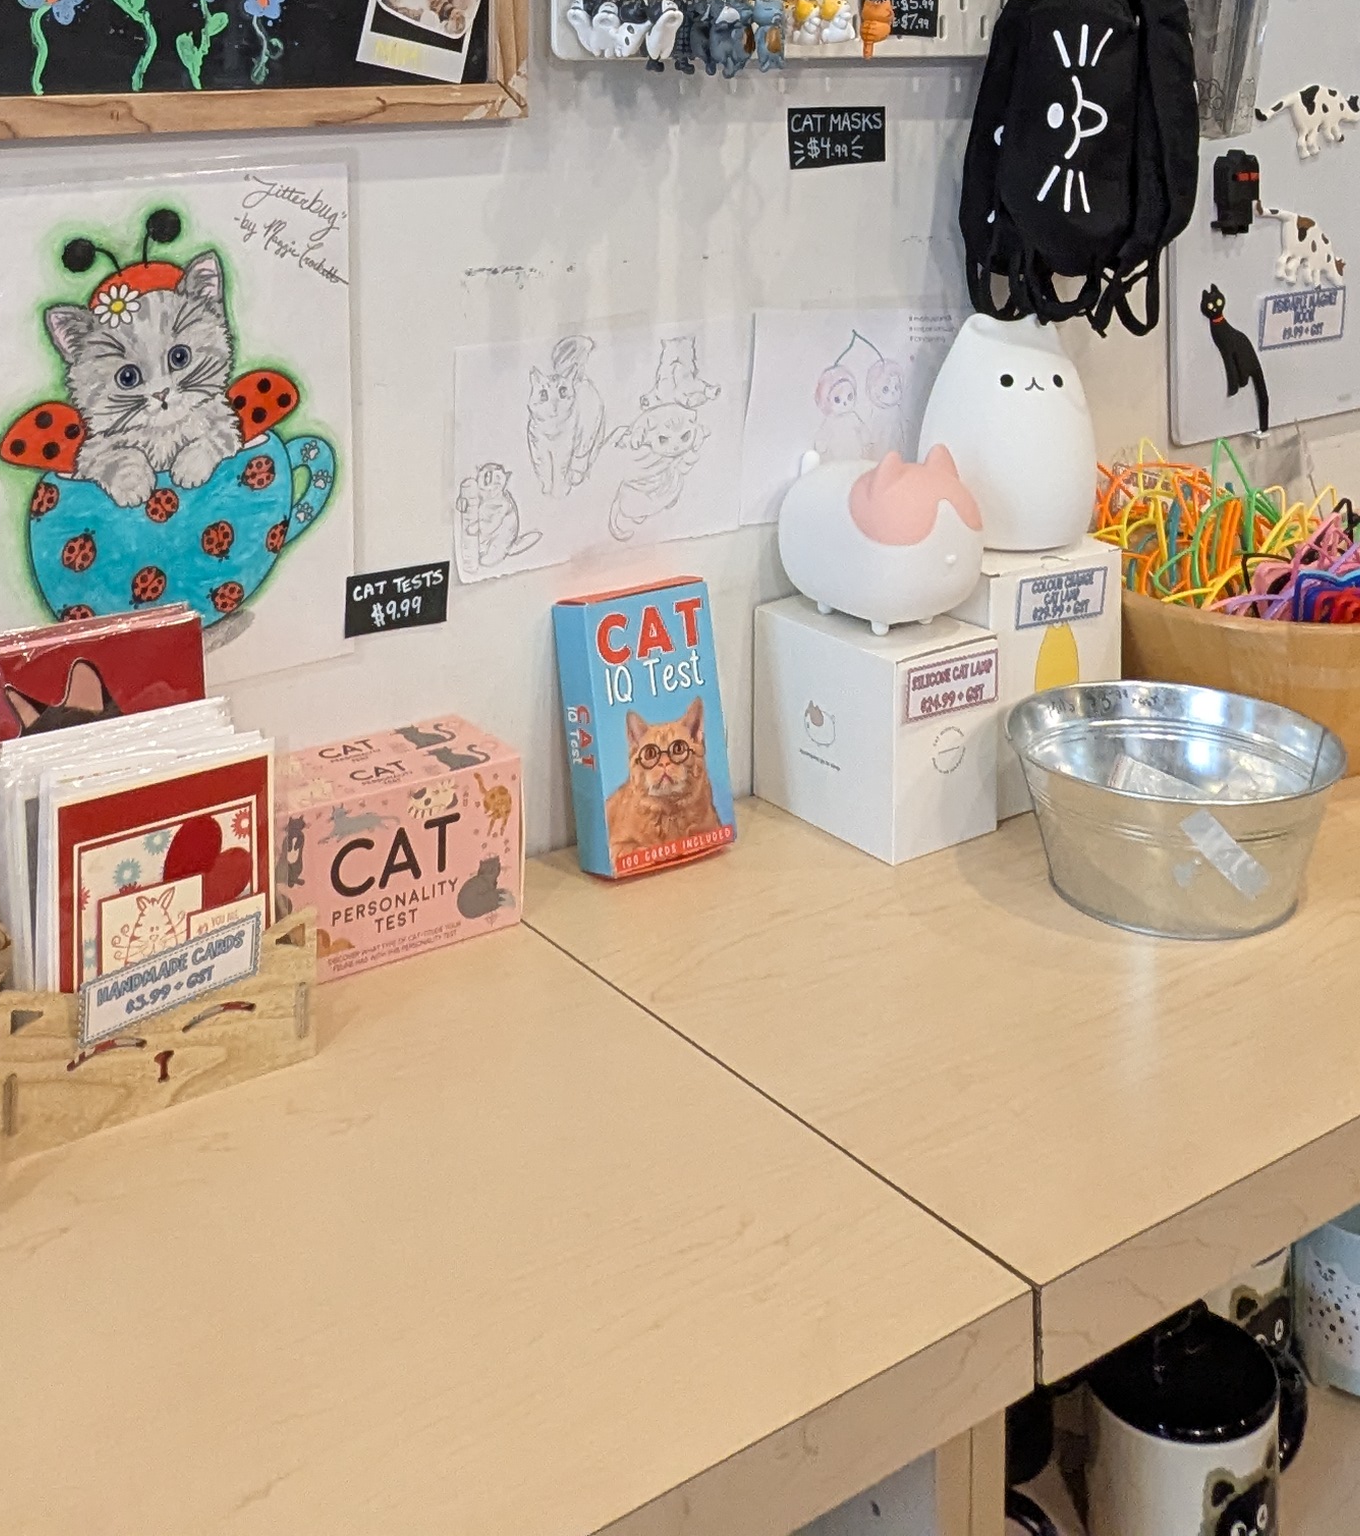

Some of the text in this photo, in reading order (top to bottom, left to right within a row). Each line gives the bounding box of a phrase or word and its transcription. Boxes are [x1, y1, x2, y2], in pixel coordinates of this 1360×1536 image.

[900, 12, 930, 30] $7.99
[790, 112, 883, 133] CAT MASKS
[806, 136, 849, 159] $4.99
[352, 569, 444, 602] CAT TESTS
[370, 595, 423, 628] $9.99
[1072, 598, 1091, 615] GST
[595, 595, 704, 667] CAT
[605, 649, 705, 707] IQ Test
[911, 658, 993, 692] SILICONE CAT LAMP
[965, 683, 986, 704] GST
[318, 738, 375, 761] CAT
[575, 704, 596, 772] CAT
[349, 760, 407, 782] CAT
[330, 812, 462, 898] CAT
[621, 826, 732, 870] 100 CARDS INCLUDED
[331, 877, 459, 928] PERSONALITY
[374, 908, 419, 934] TEST
[96, 929, 246, 1008] HANDMADE CARDS
[186, 965, 216, 990] GST
